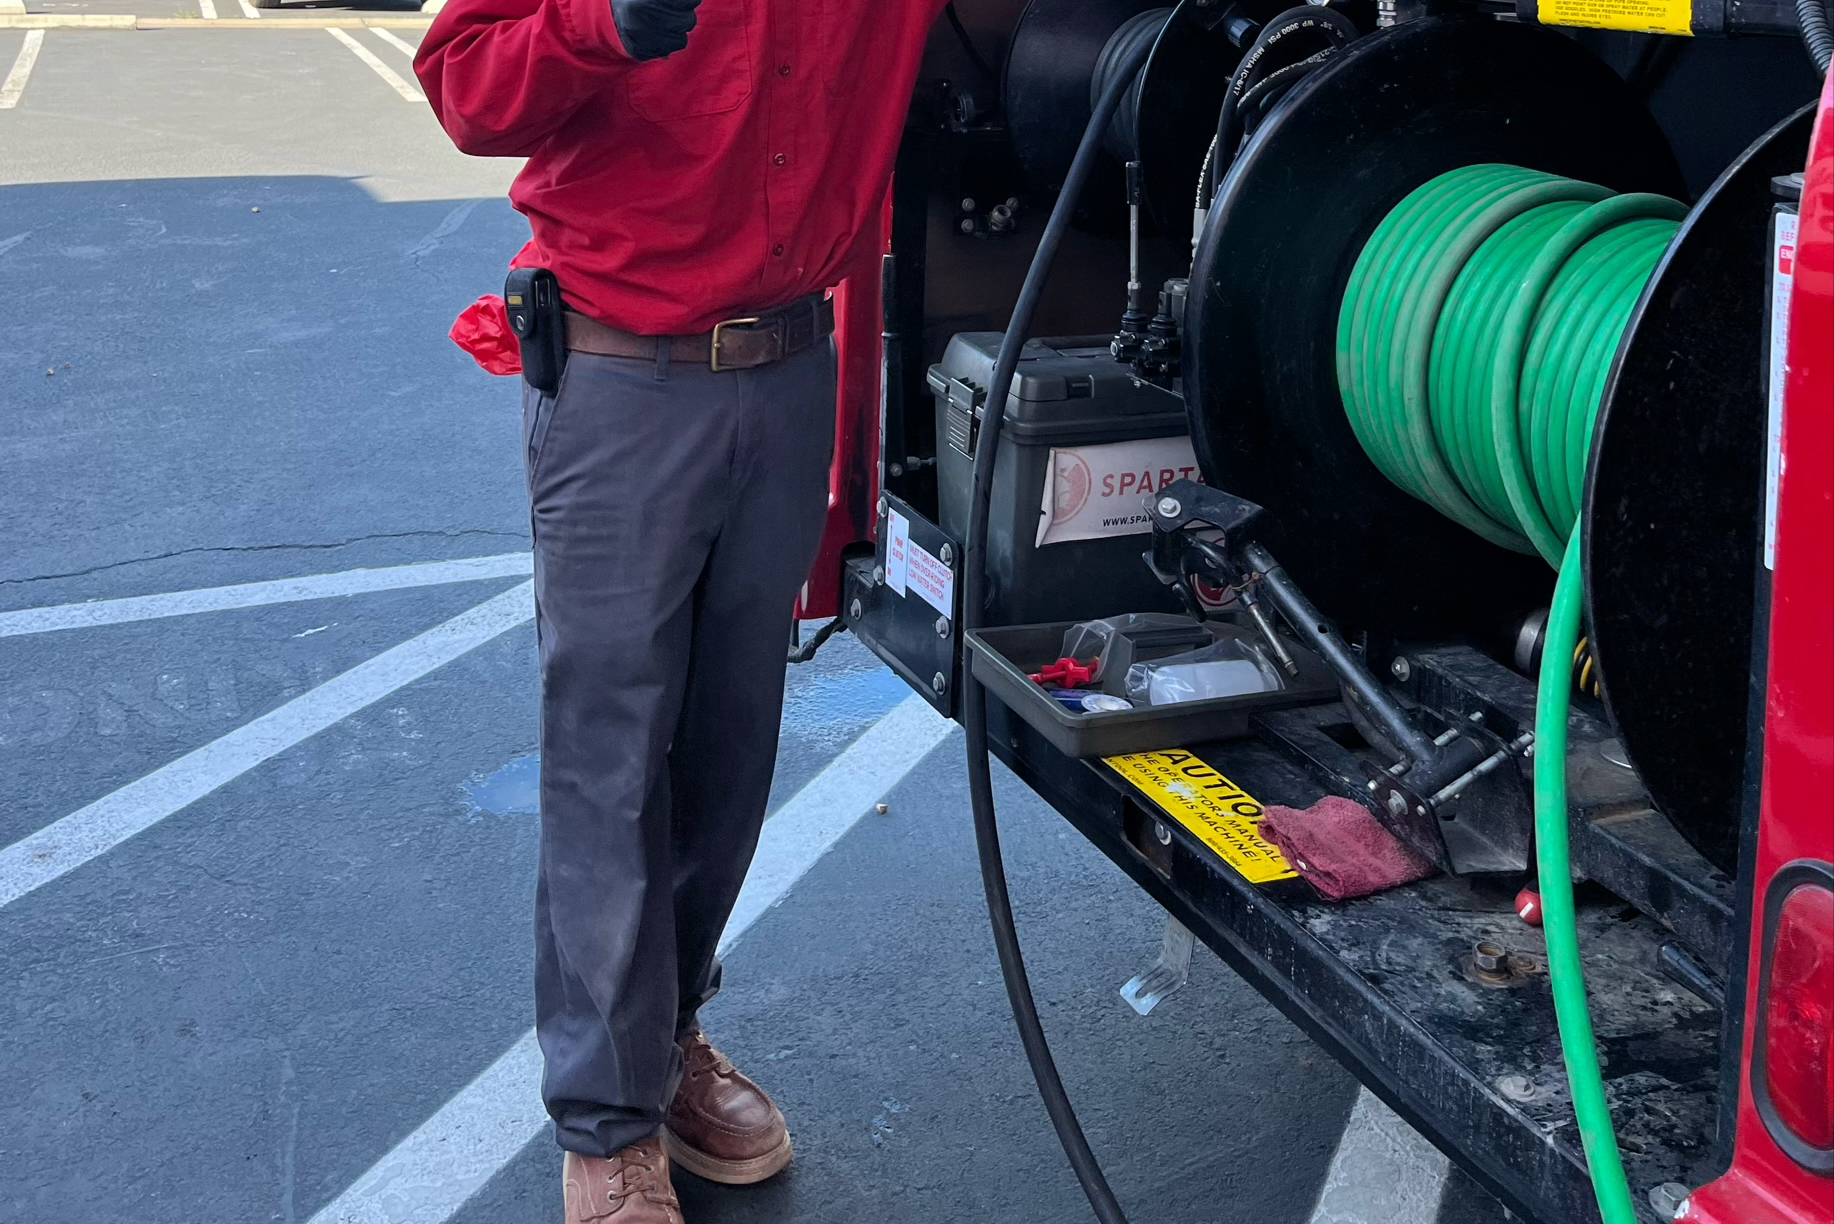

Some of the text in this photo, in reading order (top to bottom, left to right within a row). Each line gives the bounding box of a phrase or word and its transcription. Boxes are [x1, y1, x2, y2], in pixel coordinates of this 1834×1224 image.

[1281, 22, 1300, 35] 3000
[1302, 19, 1315, 28] WP
[1267, 32, 1282, 45] PSI
[1246, 46, 1265, 69] MSHA
[1101, 466, 1206, 497] SPART
[909, 556, 921, 571] WHEN
[920, 550, 930, 566] TURN
[930, 557, 938, 569] OFF
[937, 562, 953, 582] CLUTCH
[1157, 751, 1264, 825] AUTIO
[1132, 762, 1168, 788] USING
[1194, 811, 1263, 862] MACHINE!
[1139, 753, 1161, 765] HE
[1225, 818, 1282, 863] MANUAL
